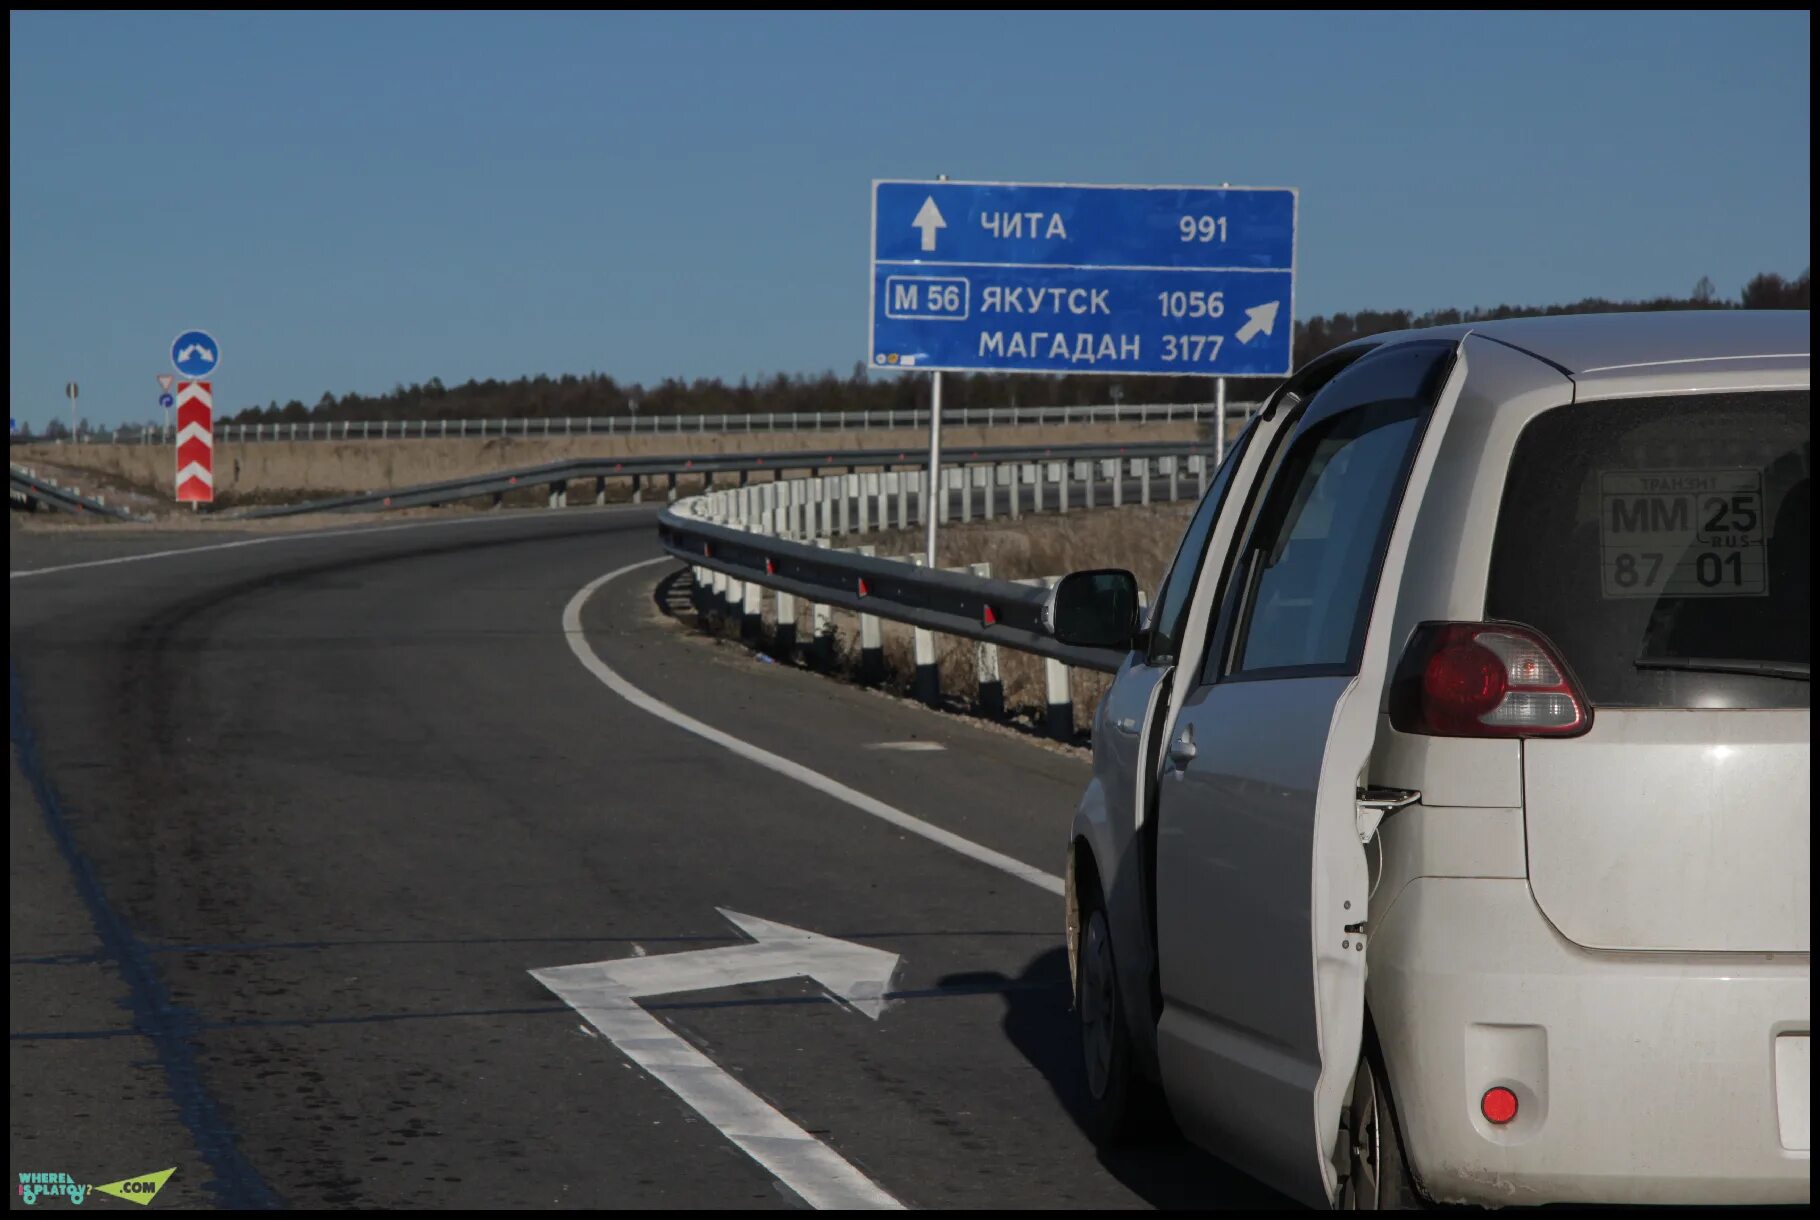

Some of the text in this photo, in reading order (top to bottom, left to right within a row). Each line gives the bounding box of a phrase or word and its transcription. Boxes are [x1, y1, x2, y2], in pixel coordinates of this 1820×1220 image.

[981, 212, 1227, 243] ЧИТА 991
[894, 286, 960, 311] М 56
[980, 287, 1224, 318] ЯКУТСК 1056
[978, 332, 1224, 363] МАГАДАН 3177
[1704, 496, 1758, 533] 25
[1711, 535, 1750, 548] RUS
[1614, 551, 1743, 588] 87 01
